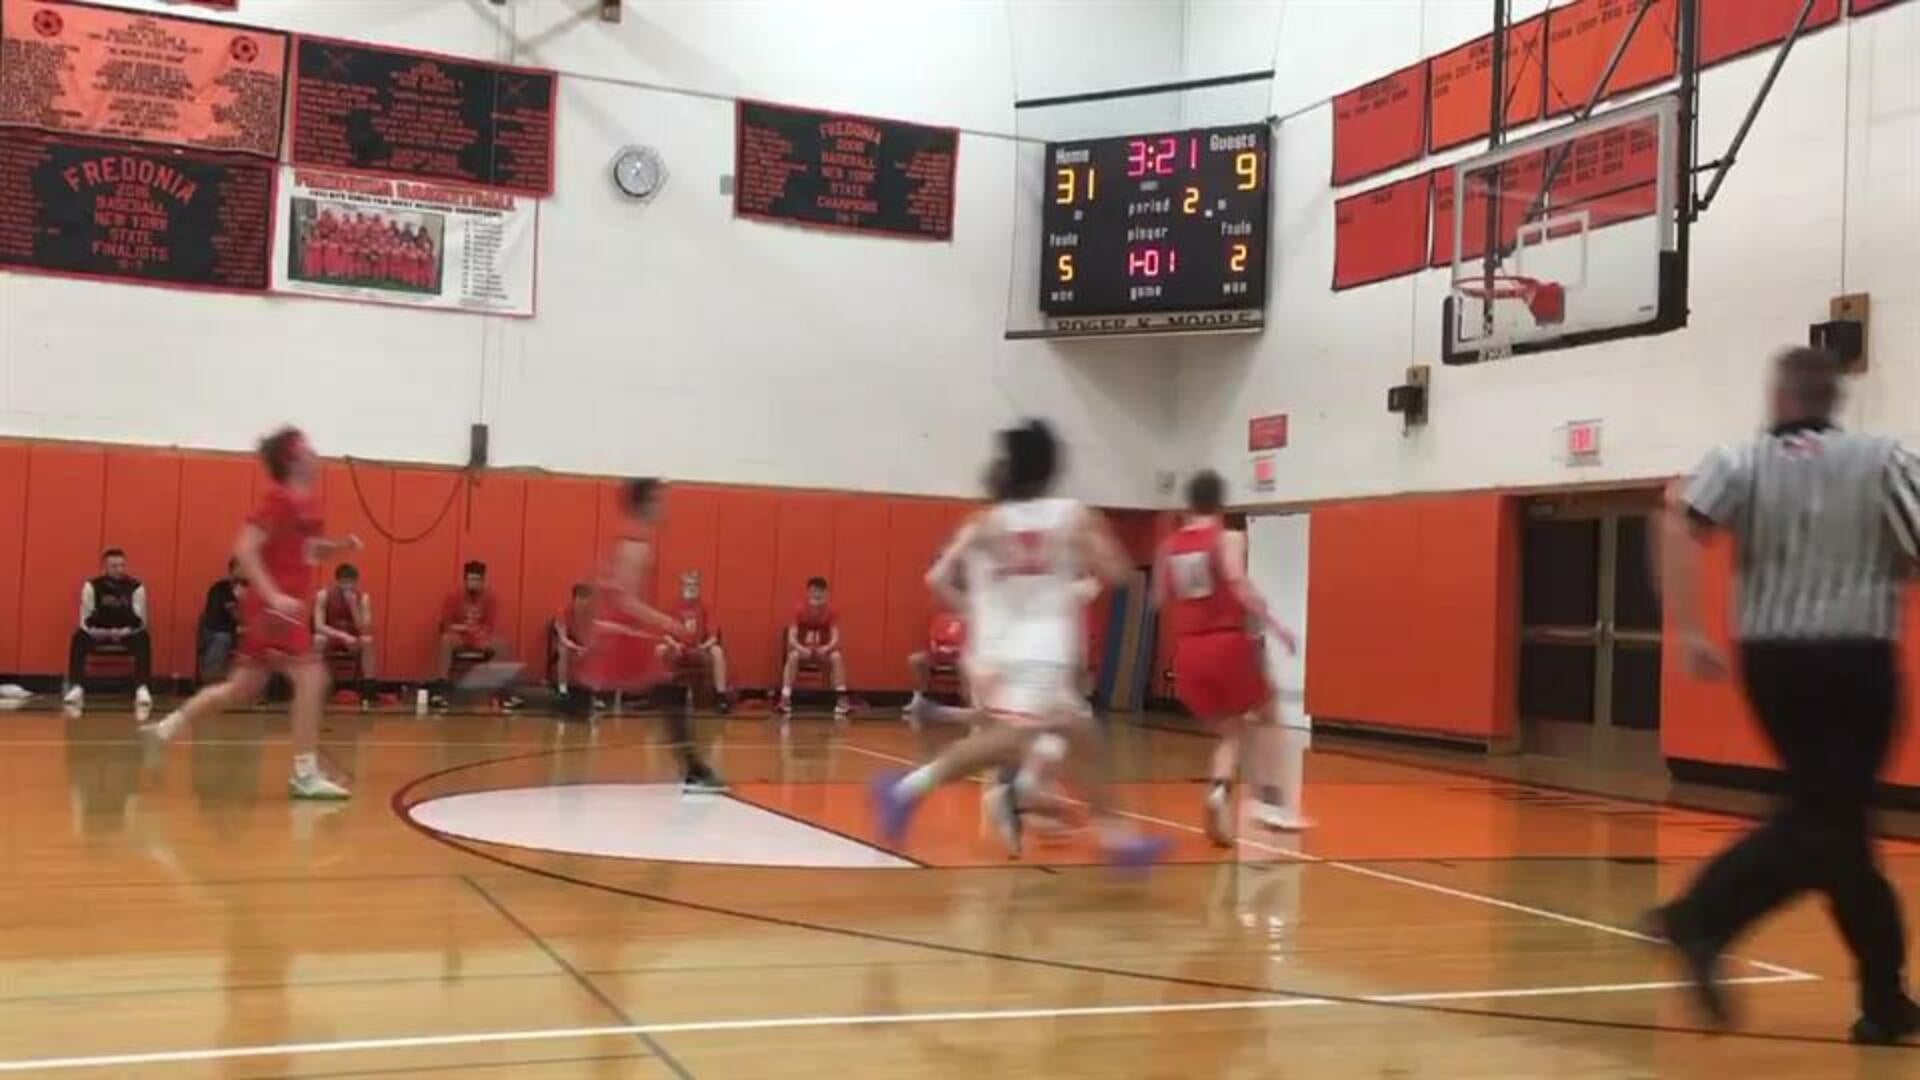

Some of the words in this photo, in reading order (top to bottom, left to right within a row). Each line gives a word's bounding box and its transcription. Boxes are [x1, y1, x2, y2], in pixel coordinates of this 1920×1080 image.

[1127, 137, 1197, 177] 3:21
[63, 156, 198, 206] FREDONIA
[1236, 152, 1257, 191] 9
[1056, 168, 1095, 204] 31
[95, 195, 164, 216] BASEBALL
[1127, 197, 1171, 217] period
[1183, 186, 1200, 214] 2
[95, 211, 127, 227] NEW
[130, 213, 169, 232] YORK
[110, 228, 152, 245] STATE
[91, 240, 172, 263] FINALISTS
[1230, 244, 1248, 272] 2
[1058, 254, 1074, 281] 5
[1056, 317, 1127, 333] ROGER
[1167, 311, 1251, 329] MOORE
